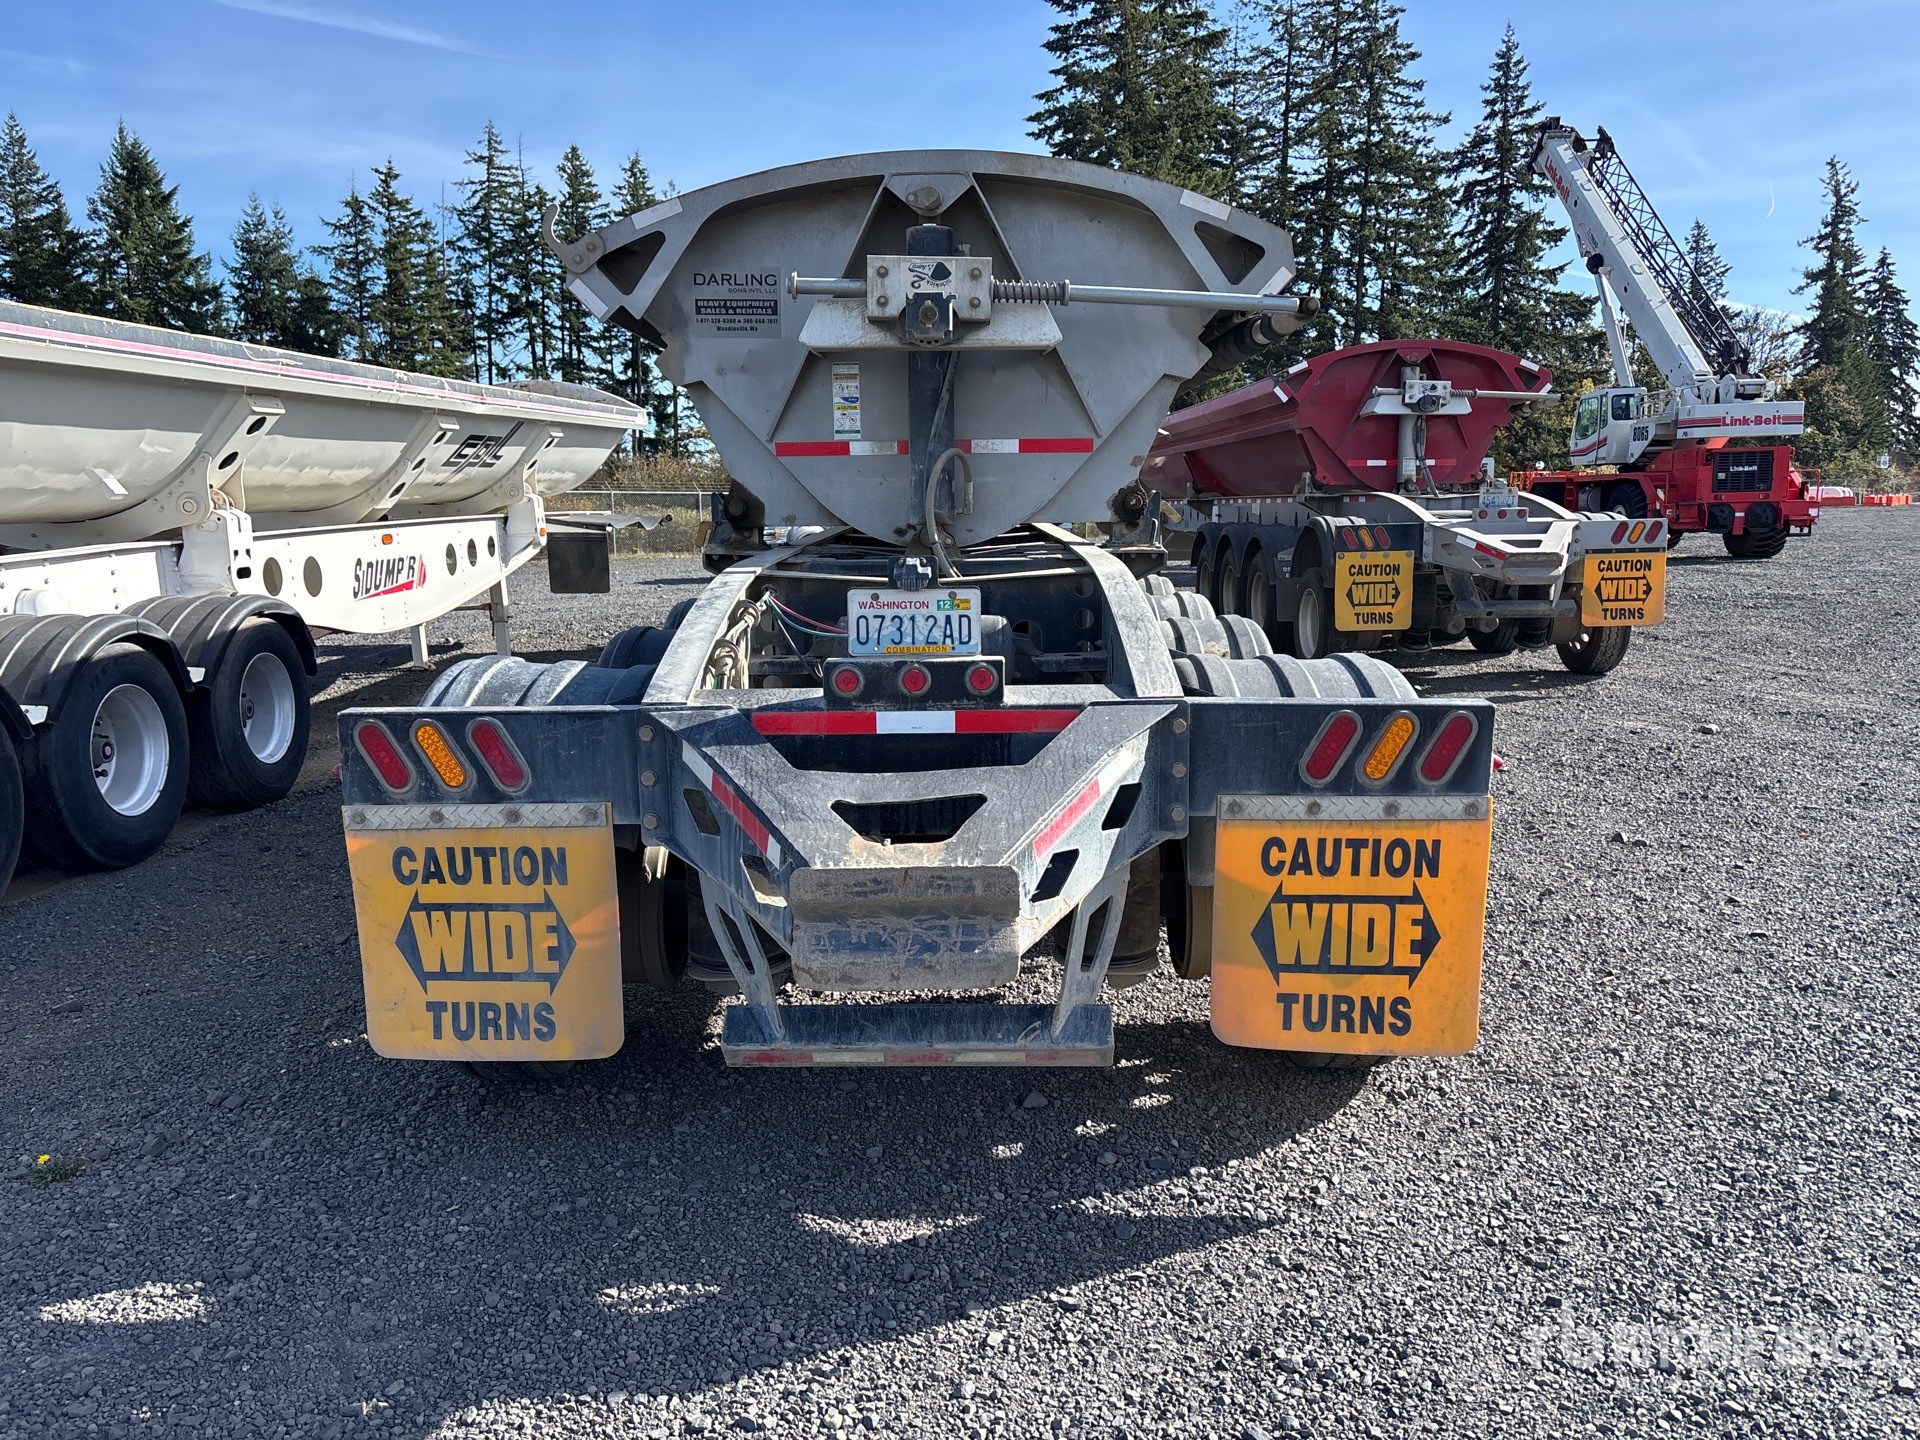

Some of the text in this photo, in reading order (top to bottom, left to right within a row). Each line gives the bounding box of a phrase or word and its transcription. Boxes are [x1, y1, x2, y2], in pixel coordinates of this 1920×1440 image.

[1545, 155, 1570, 204] Link-Belt
[693, 273, 777, 286] DARLING
[1721, 414, 1782, 427] Link-Belt
[1633, 426, 1649, 441] 8065
[1348, 564, 1400, 577] CAUTION
[1598, 559, 1652, 572] CAUTION
[1351, 583, 1396, 604] WIDE
[1600, 579, 1647, 600] WIDE
[858, 601, 929, 610] WASHINGTON
[938, 601, 951, 609] 12
[1602, 607, 1644, 620] TURNS
[1354, 612, 1393, 624] TURNS
[856, 614, 972, 646] 07312AD
[392, 846, 568, 886] CAUTION
[1261, 836, 1441, 878] CAUTION
[409, 911, 560, 974] WIDE
[1270, 902, 1424, 967] WIDE
[425, 1001, 557, 1041] TURNS
[1276, 993, 1412, 1036] TURNS
